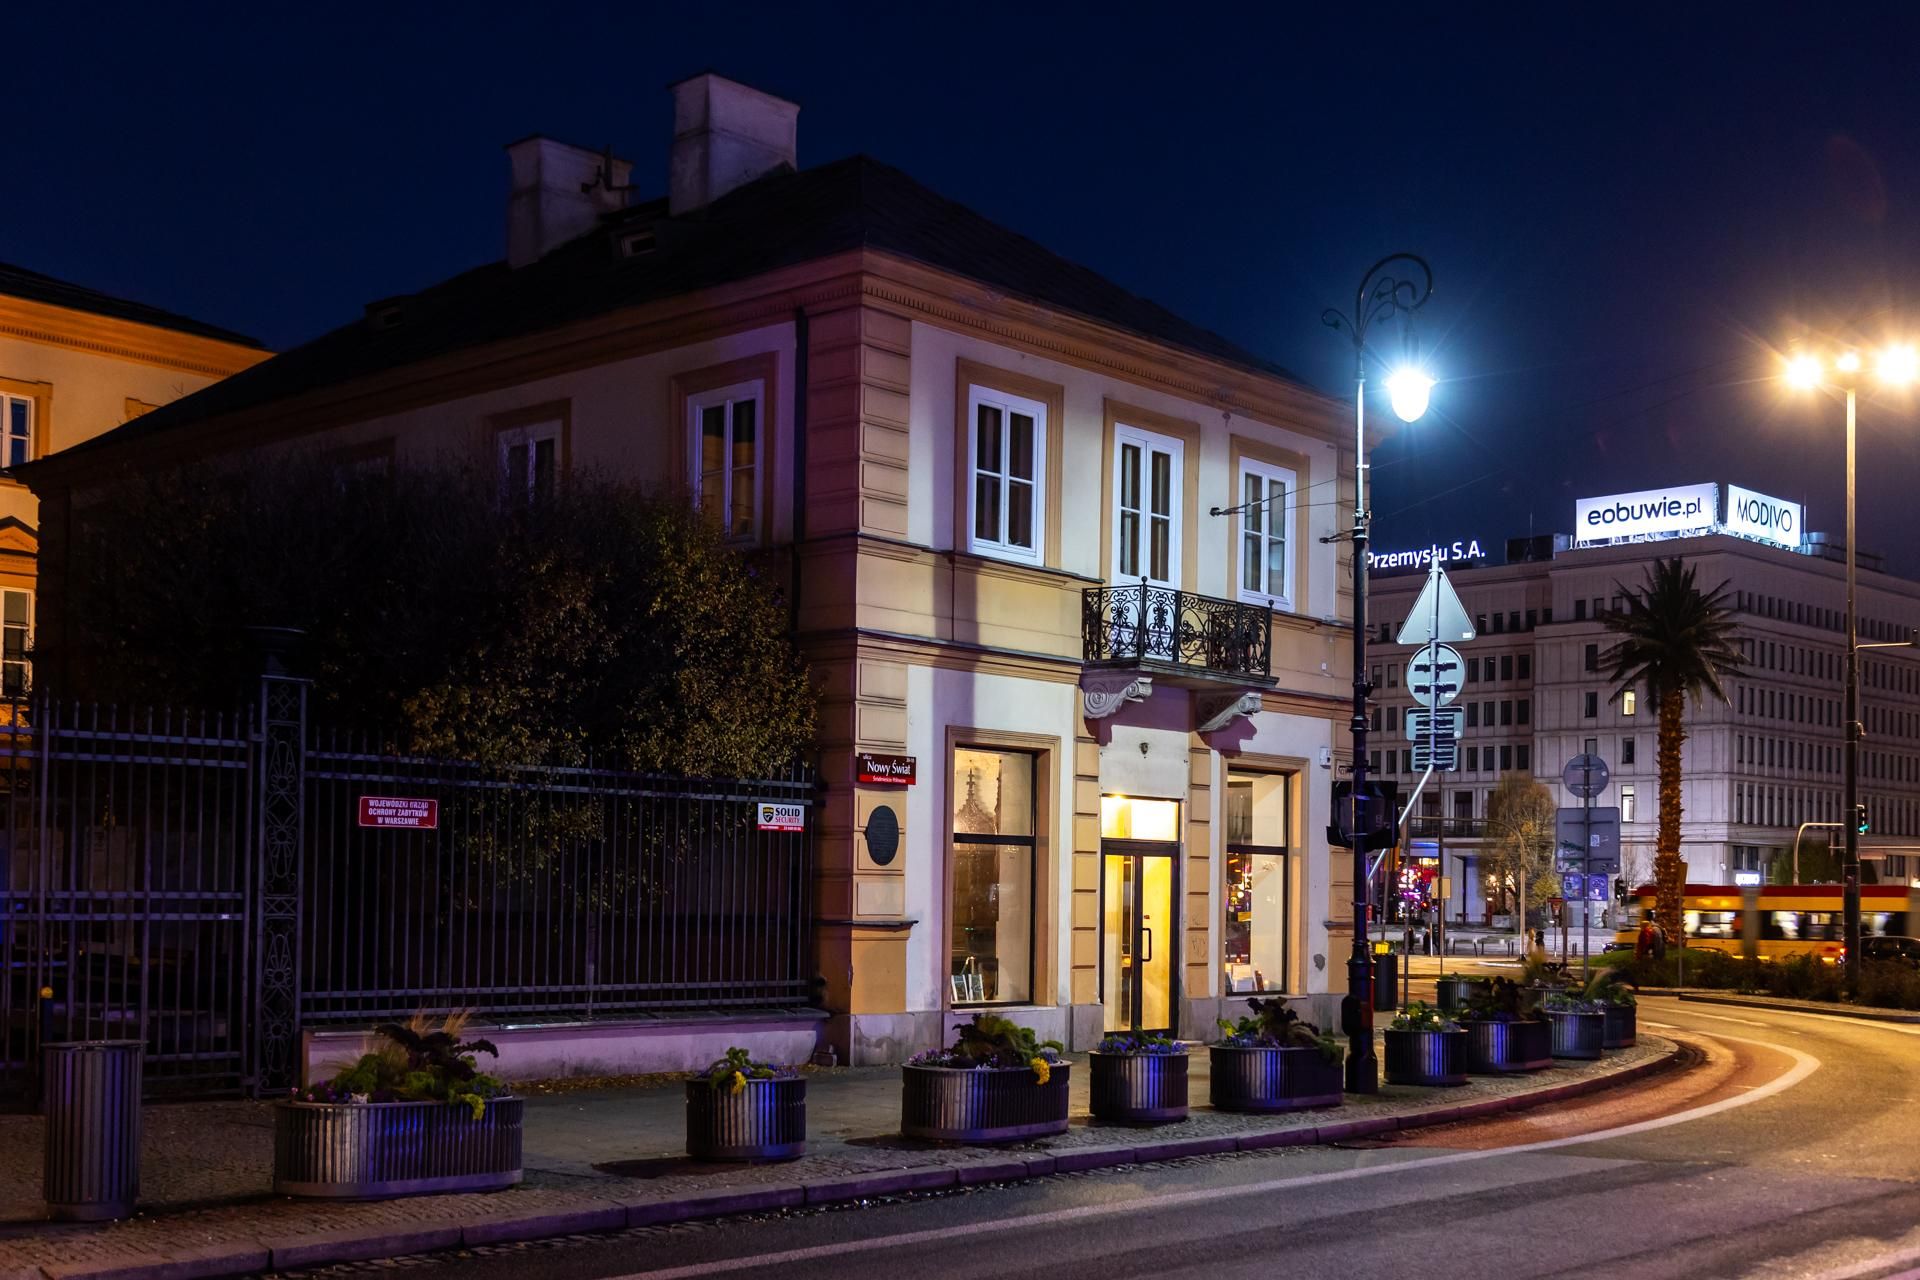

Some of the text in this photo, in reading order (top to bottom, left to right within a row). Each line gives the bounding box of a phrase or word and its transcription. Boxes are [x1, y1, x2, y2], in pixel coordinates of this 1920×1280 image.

[1587, 496, 1702, 526] eobuwie.pl
[1737, 496, 1793, 532] MODIVO
[1452, 540, 1486, 560] S.A.
[867, 760, 911, 777] Nowy Świat
[368, 808, 396, 817] OCHRONY
[775, 807, 800, 817] SOLID
[377, 816, 419, 826] W WARSZAWIE
